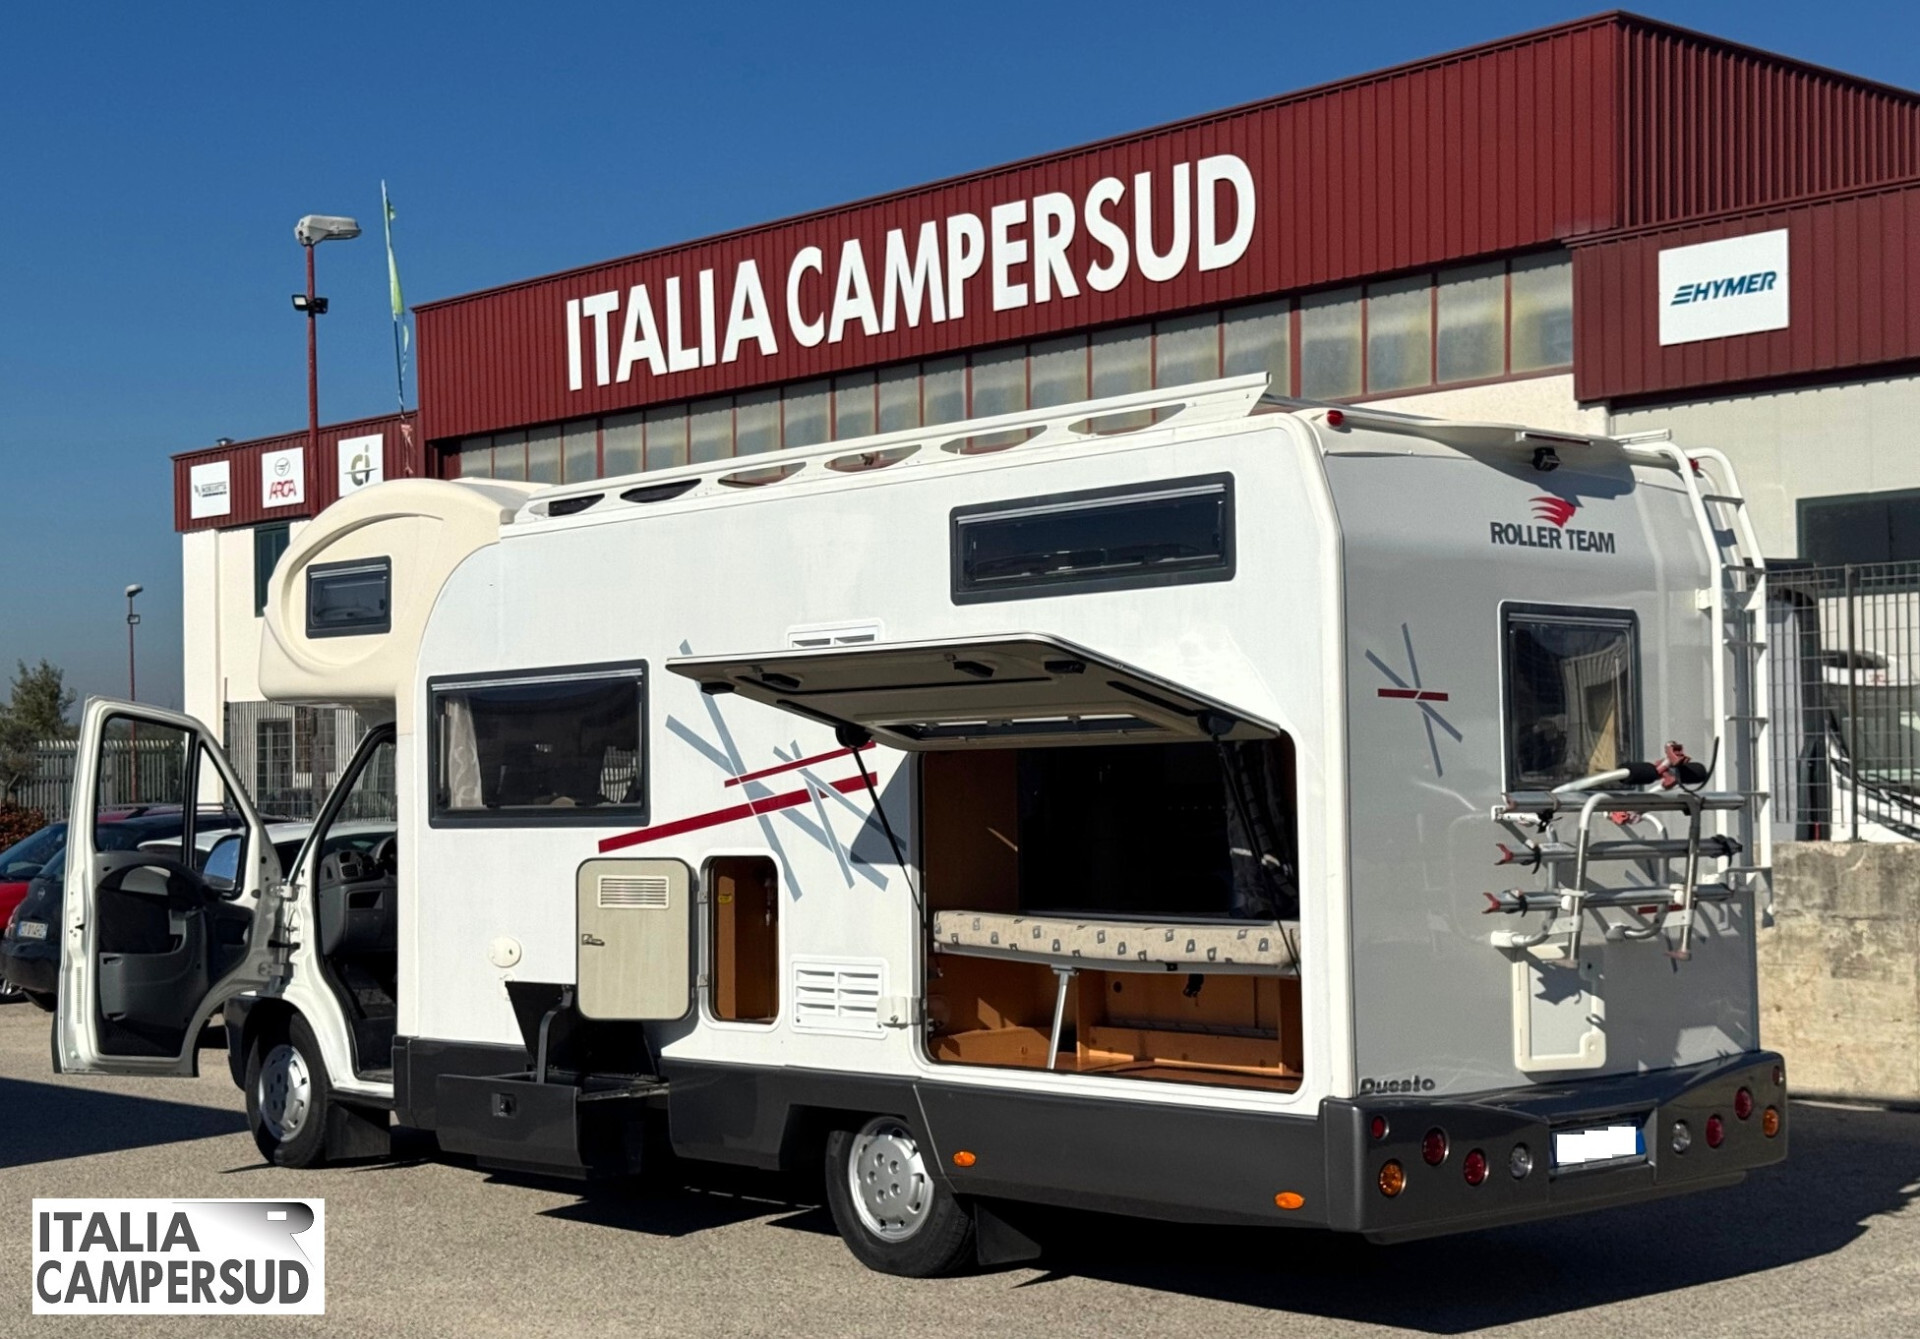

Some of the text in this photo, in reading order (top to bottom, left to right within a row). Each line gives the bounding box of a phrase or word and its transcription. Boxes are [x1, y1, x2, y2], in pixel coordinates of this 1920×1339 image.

[566, 154, 1256, 391] ITALIA CAMPERSUD
[1692, 270, 1777, 303] HYMER
[269, 479, 297, 500] ARCA
[1490, 522, 1616, 554] ROLLER TEAM
[1359, 1075, 1436, 1095] Ducato
